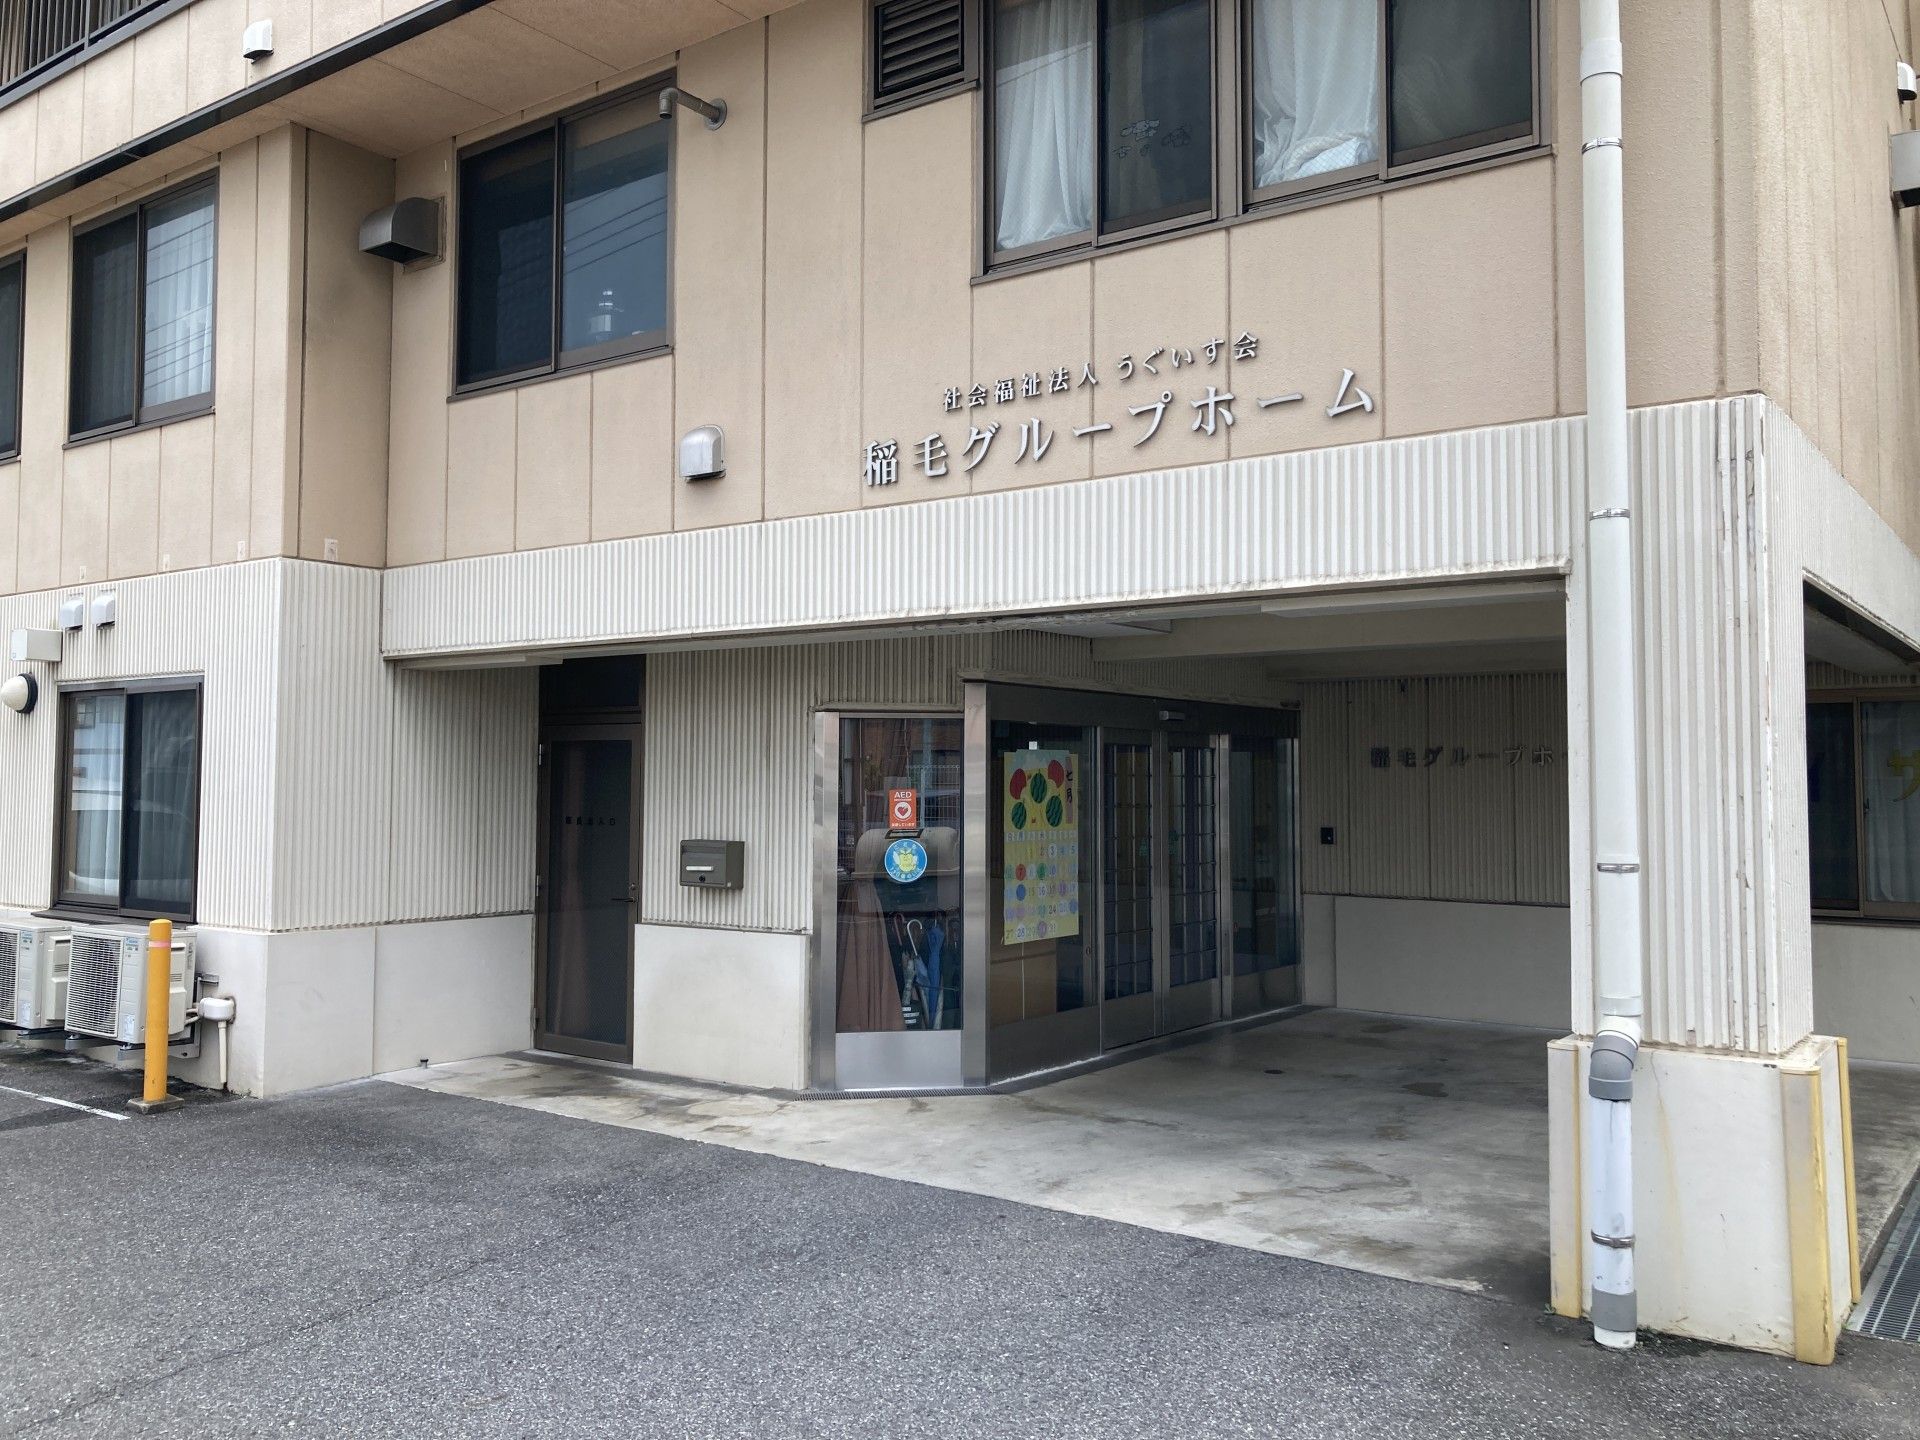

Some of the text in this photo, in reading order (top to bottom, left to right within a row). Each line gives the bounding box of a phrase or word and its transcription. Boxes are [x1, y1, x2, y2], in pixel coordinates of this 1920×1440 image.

[942, 331, 1259, 413] 社会福祉法人 うぐいす会
[862, 368, 1375, 488] 稲毛グループホーム
[894, 791, 912, 799] AED
